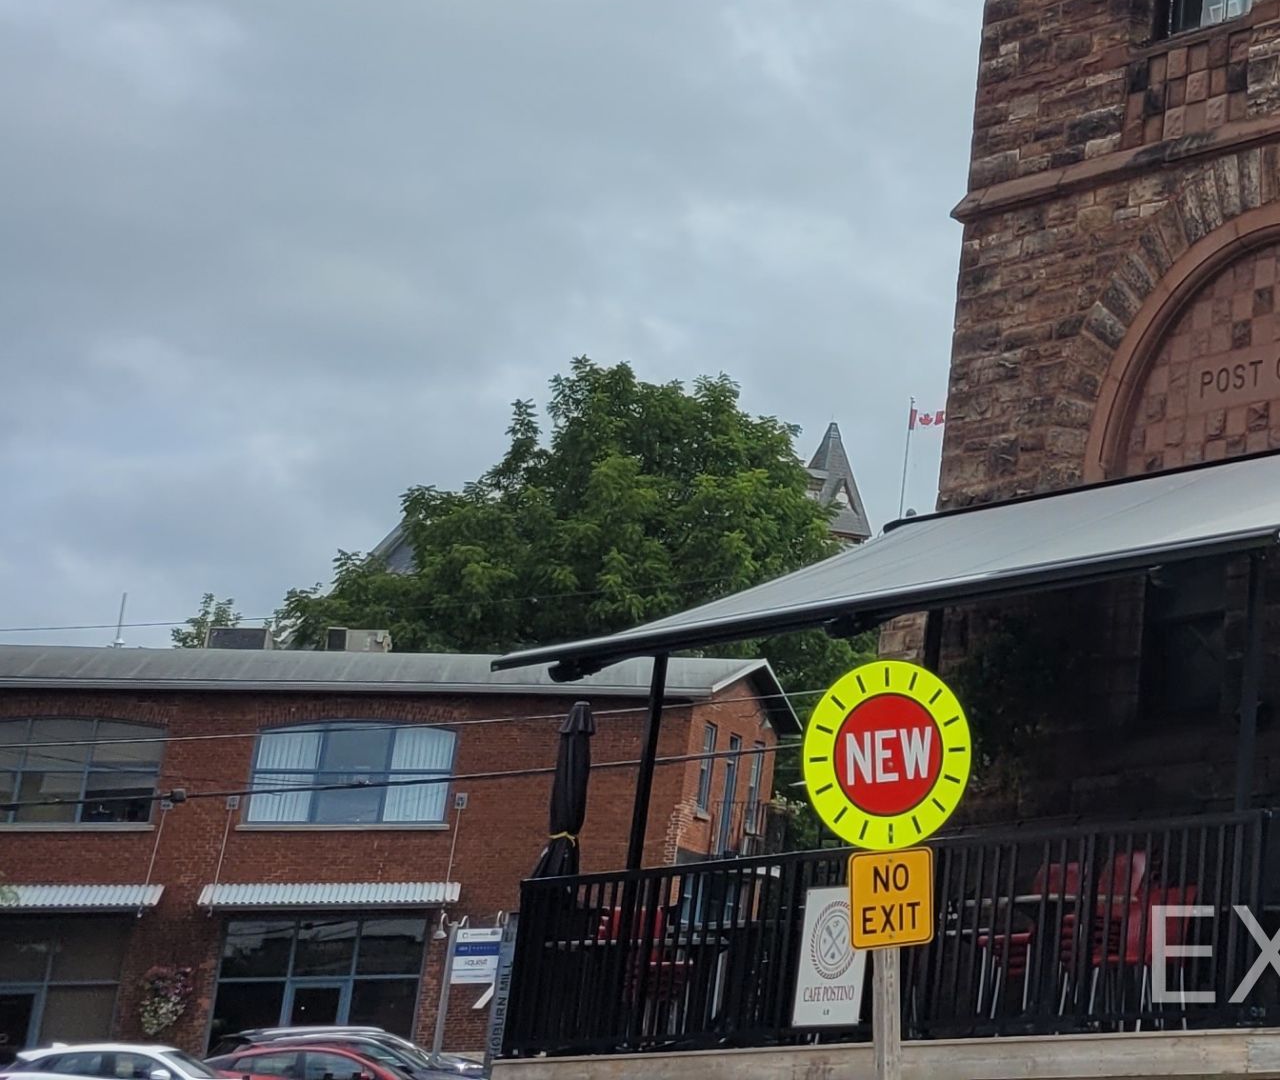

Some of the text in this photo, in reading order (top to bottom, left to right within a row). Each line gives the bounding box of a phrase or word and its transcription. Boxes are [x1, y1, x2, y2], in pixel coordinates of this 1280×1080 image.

[1200, 360, 1264, 398] POST
[846, 726, 932, 786] NEW
[873, 863, 909, 894] NO
[862, 901, 921, 935] EXIT
[821, 984, 855, 1002] POSTINO
